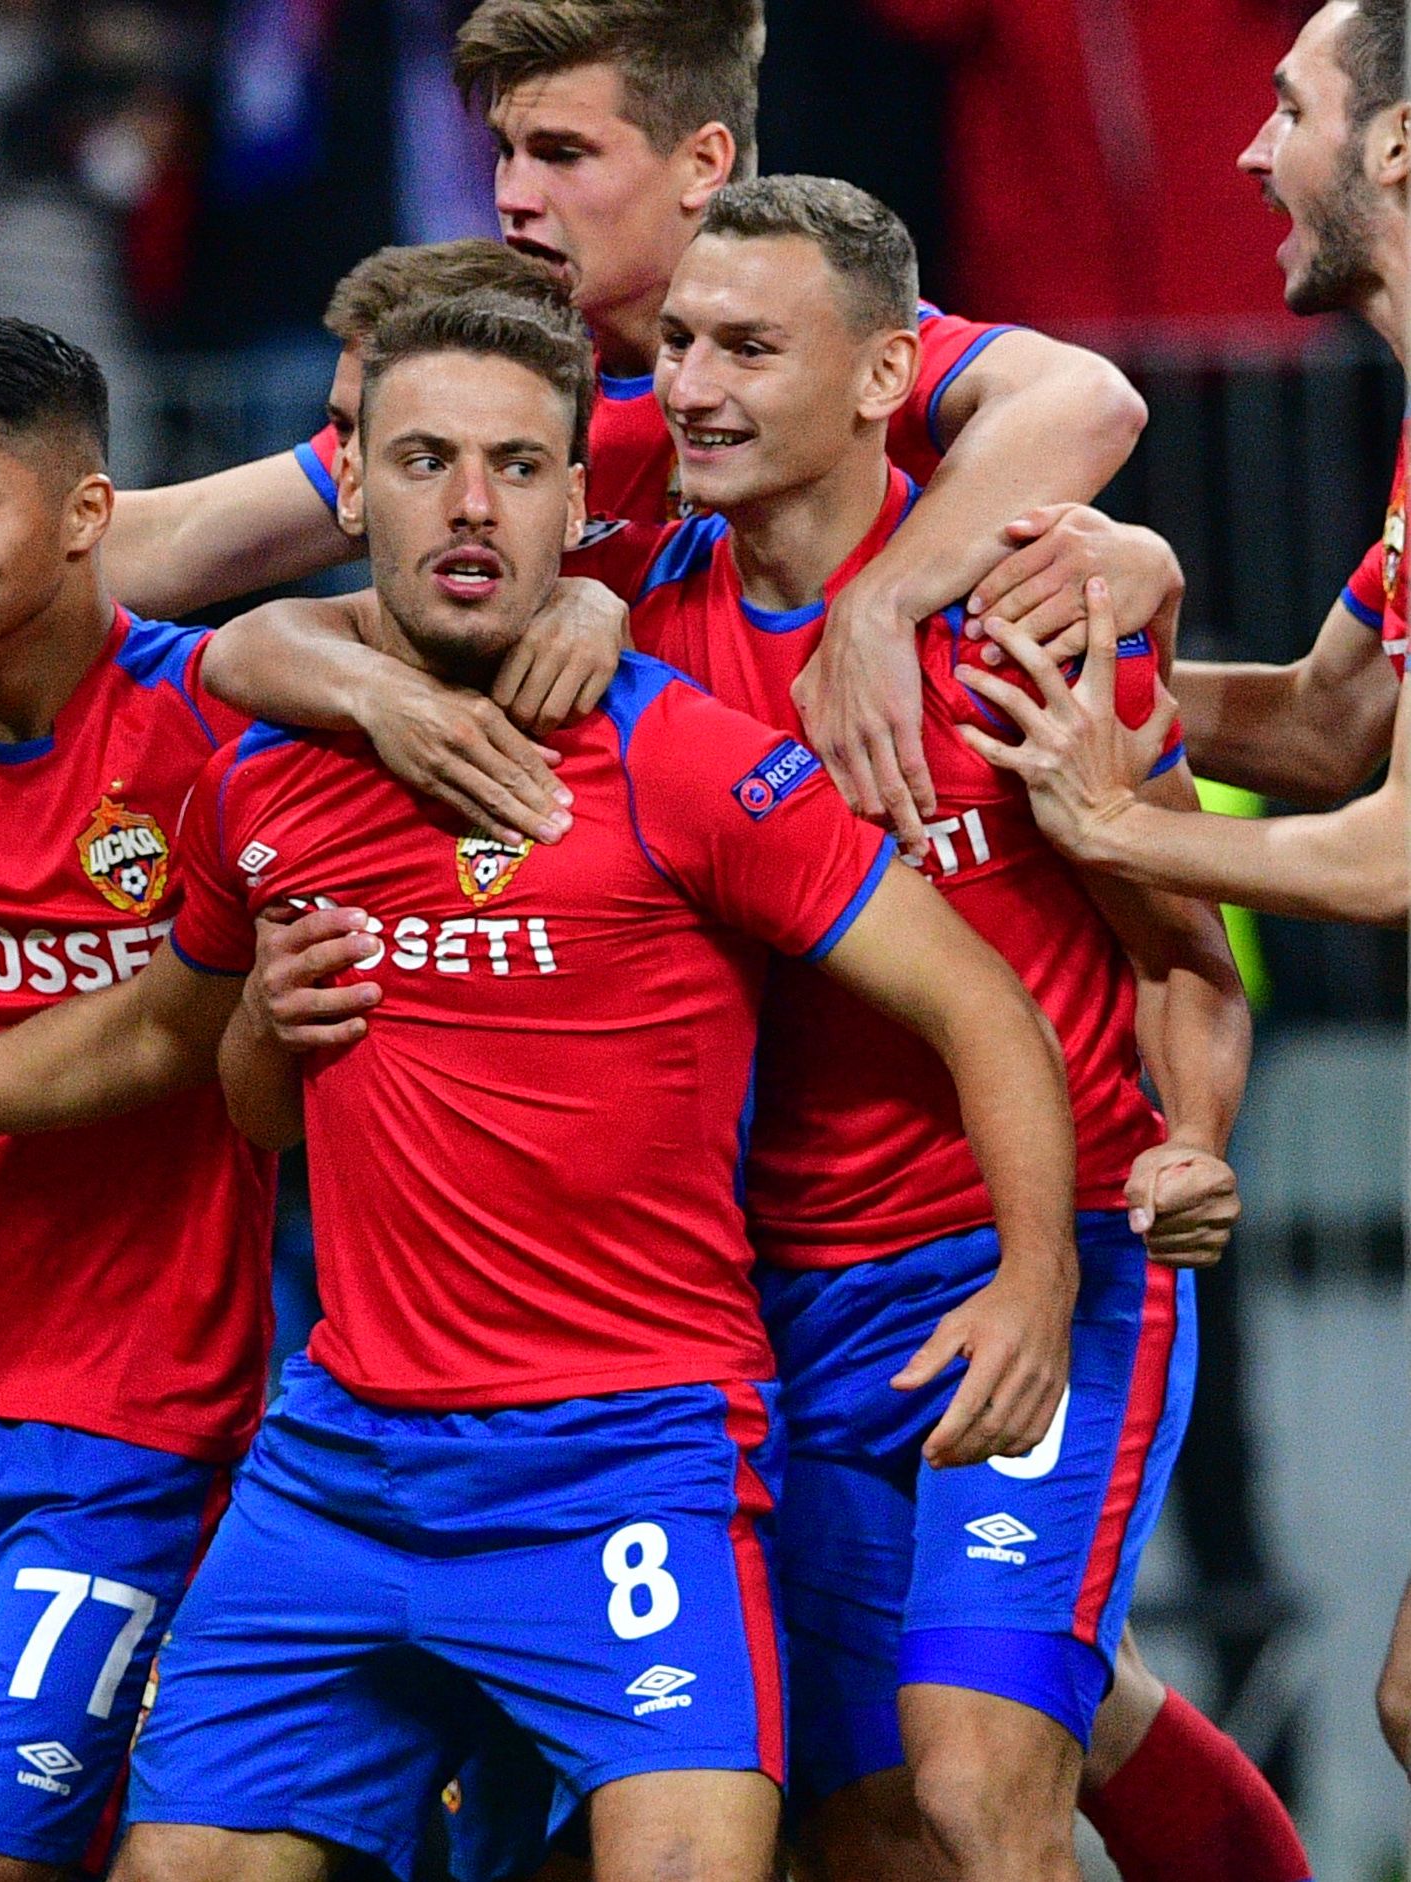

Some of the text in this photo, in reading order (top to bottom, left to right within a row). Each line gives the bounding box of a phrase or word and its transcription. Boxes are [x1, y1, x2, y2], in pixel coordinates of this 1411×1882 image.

[89, 827, 164, 875] ЦСКА
[967, 1545, 1026, 1565] umbro
[602, 1522, 680, 1640] 8
[8, 1567, 157, 1720] 77
[633, 1694, 692, 1716] umbro
[17, 1770, 71, 1796] umbro
